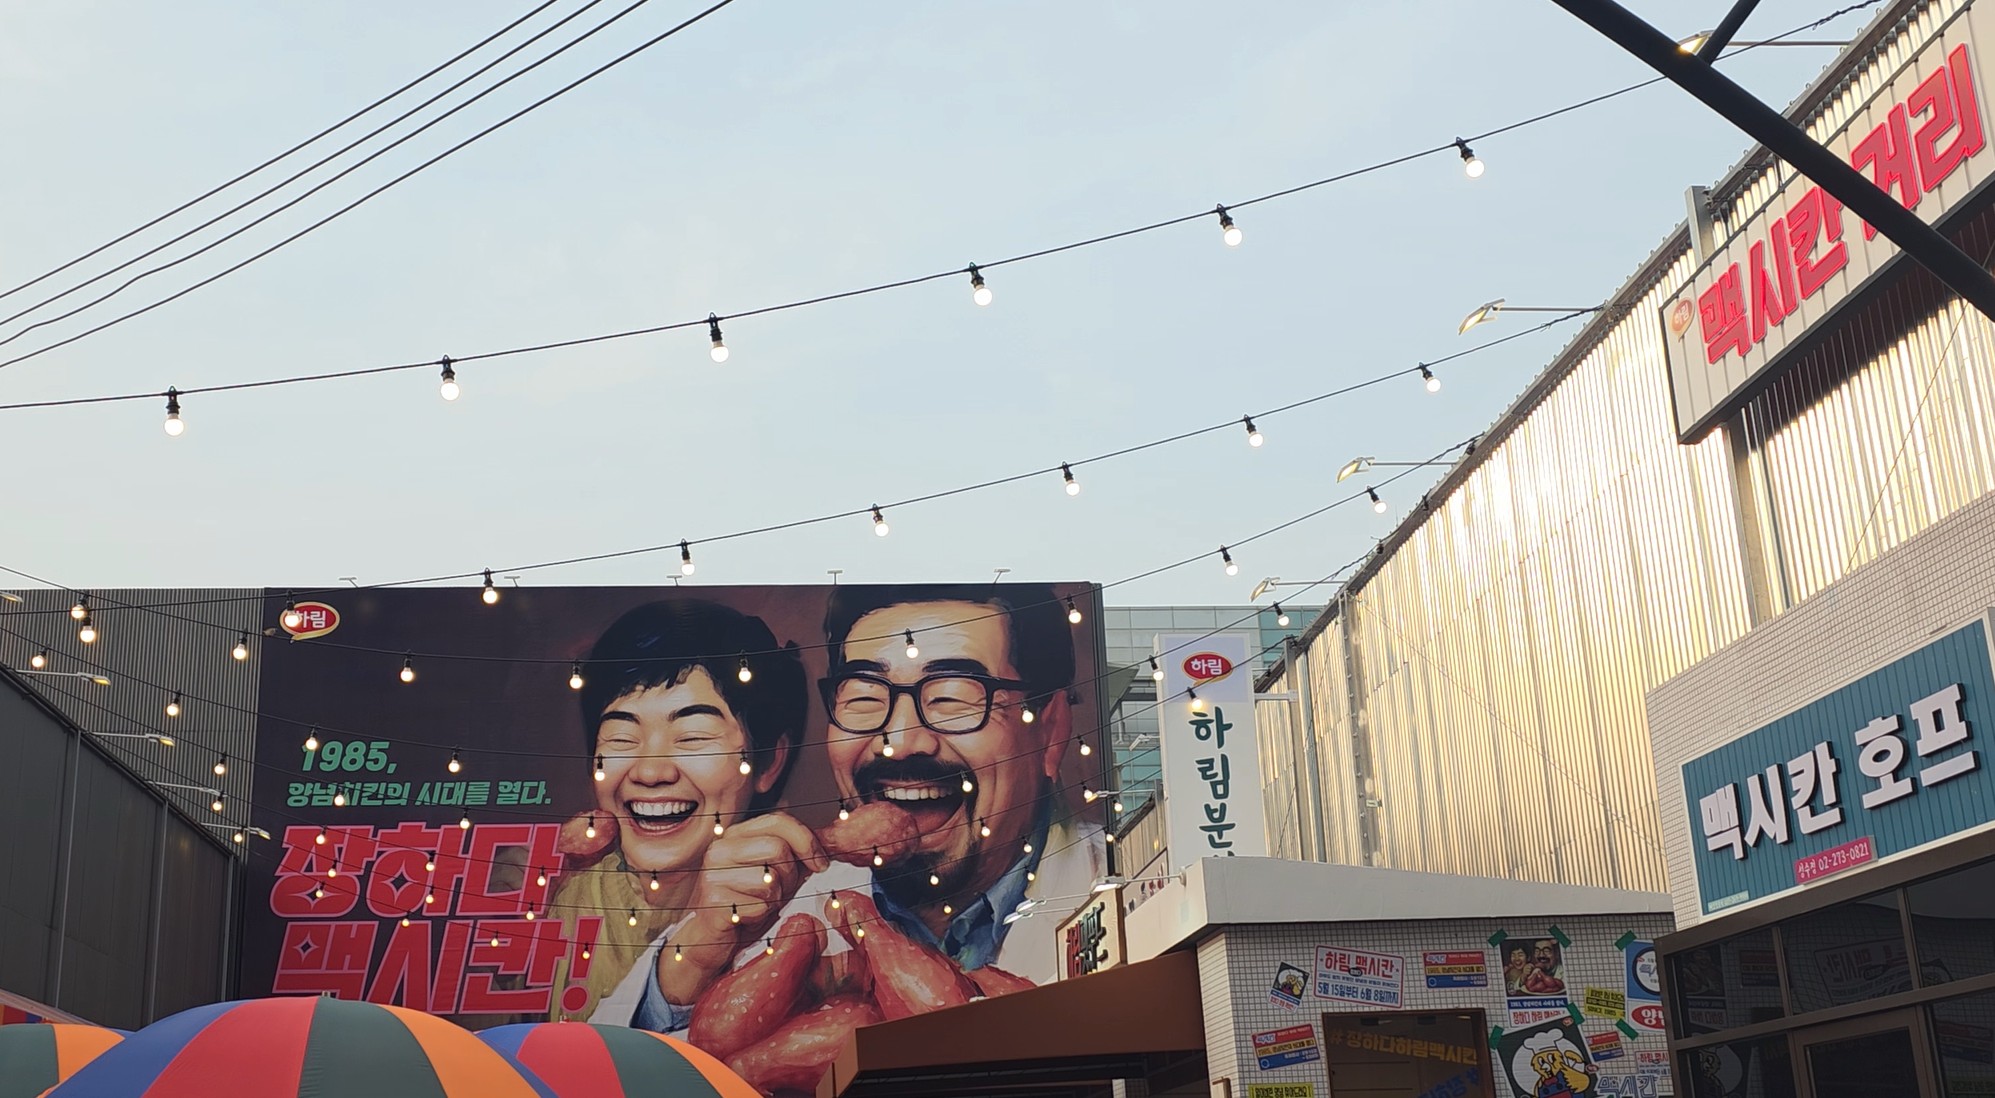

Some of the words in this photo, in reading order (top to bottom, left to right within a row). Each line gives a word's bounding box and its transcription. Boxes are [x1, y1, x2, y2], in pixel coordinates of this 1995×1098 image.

[1698, 186, 1849, 365] 맥시칸
[1850, 43, 1986, 241] 거리
[1190, 658, 1223, 676] 하림
[301, 740, 398, 774] 1985,
[1188, 705, 1237, 857] 하림분
[1699, 740, 1842, 860] 맥시칸
[1854, 682, 1979, 811] 호프
[286, 781, 412, 807] 양념치킨의
[414, 781, 491, 806] 시대를
[496, 780, 552, 806] 열다.
[269, 821, 566, 918] 장하다
[1818, 842, 1869, 871] 02-273-0821
[271, 916, 604, 1014] 맥시칸!
[1325, 951, 1350, 973] 하림
[1355, 955, 1395, 979] 맥시칸
